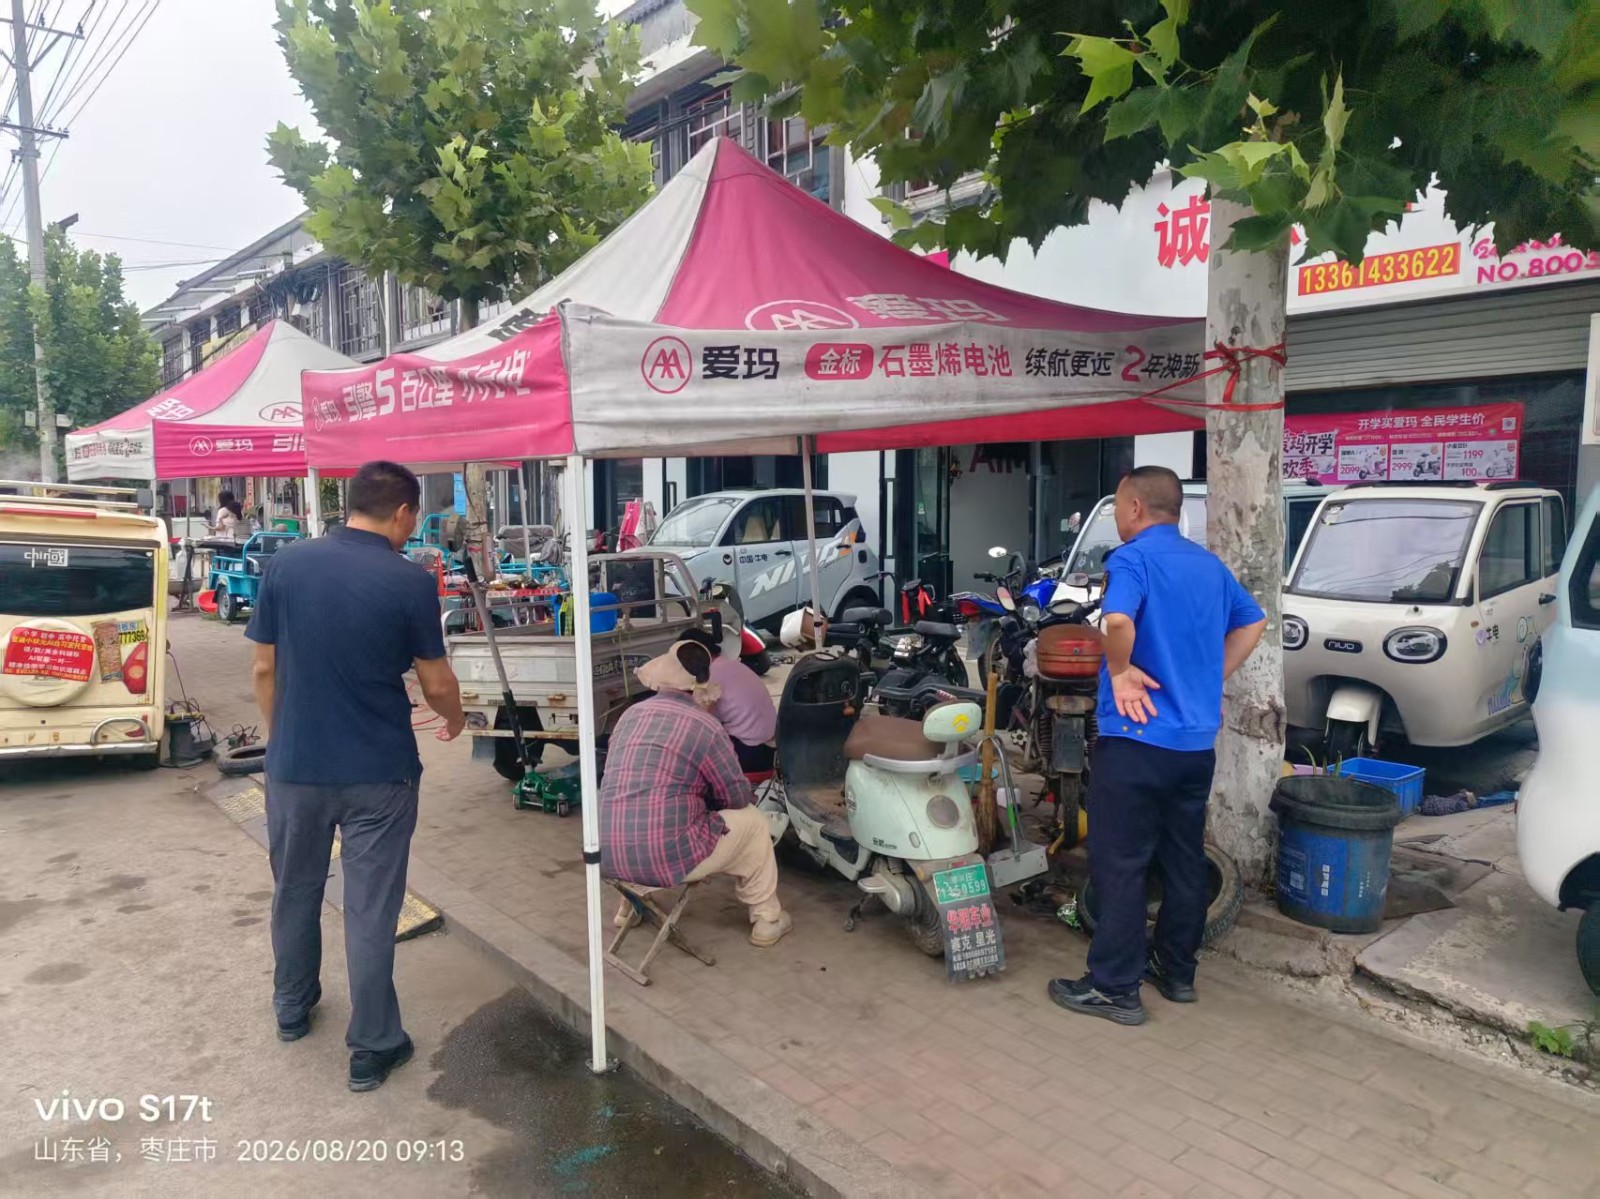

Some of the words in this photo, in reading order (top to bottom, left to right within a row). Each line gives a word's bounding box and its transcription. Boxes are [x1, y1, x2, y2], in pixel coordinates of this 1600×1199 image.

[1303, 245, 1455, 294] 13361433622
[701, 344, 780, 381] 爱玛
[817, 347, 862, 376] 金标
[878, 343, 1013, 379] 石墨烯电池
[1025, 346, 1115, 378] 续航更远
[1120, 344, 1199, 384] 2年换新
[1358, 415, 1417, 431] 开学买爱玛
[1420, 413, 1486, 428] 全民学生价
[216, 439, 253, 452] 爱玛
[272, 434, 304, 454] 引
